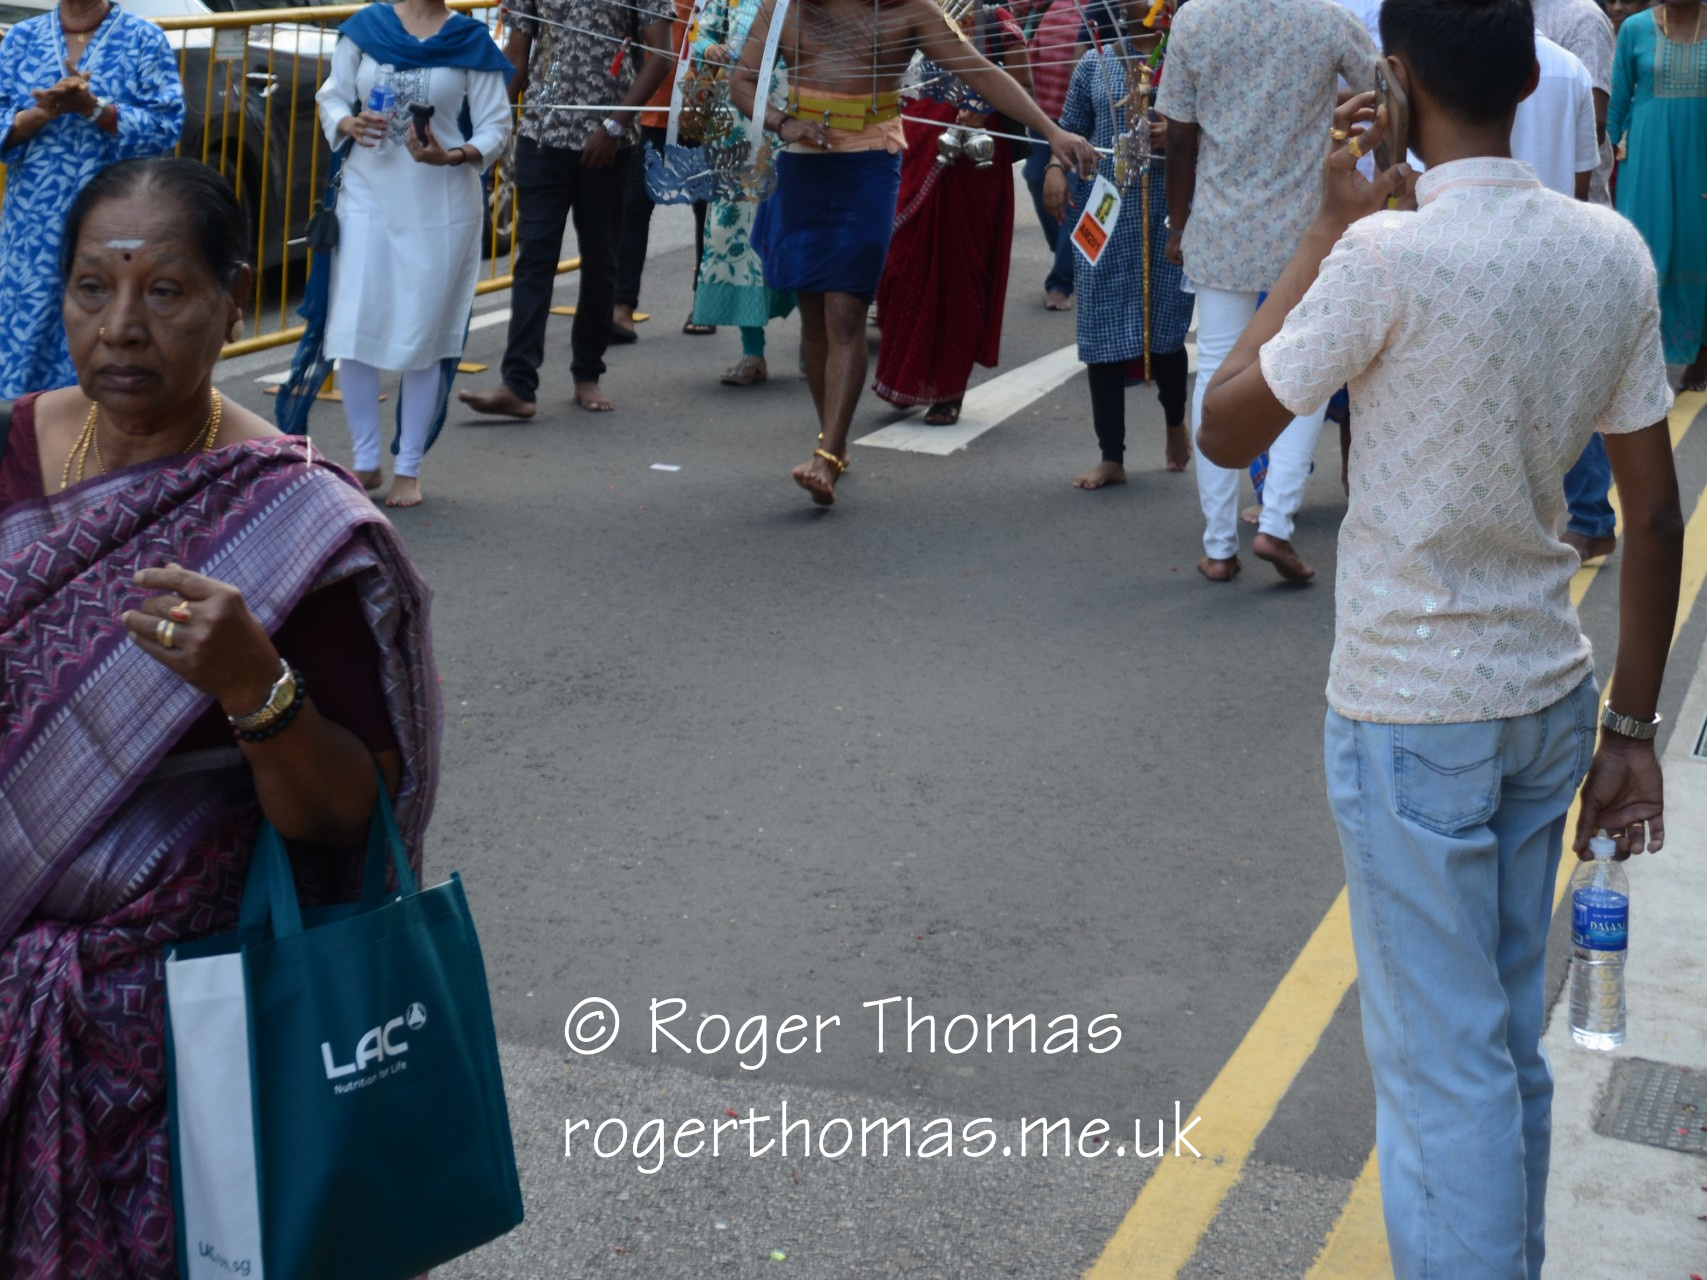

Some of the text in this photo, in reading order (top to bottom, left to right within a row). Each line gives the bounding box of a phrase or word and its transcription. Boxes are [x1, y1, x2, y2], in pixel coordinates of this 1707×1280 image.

[1590, 920, 1626, 932] DASANI
[320, 1015, 409, 1080] LAC
[334, 1060, 407, 1095] Nutrition for Life
